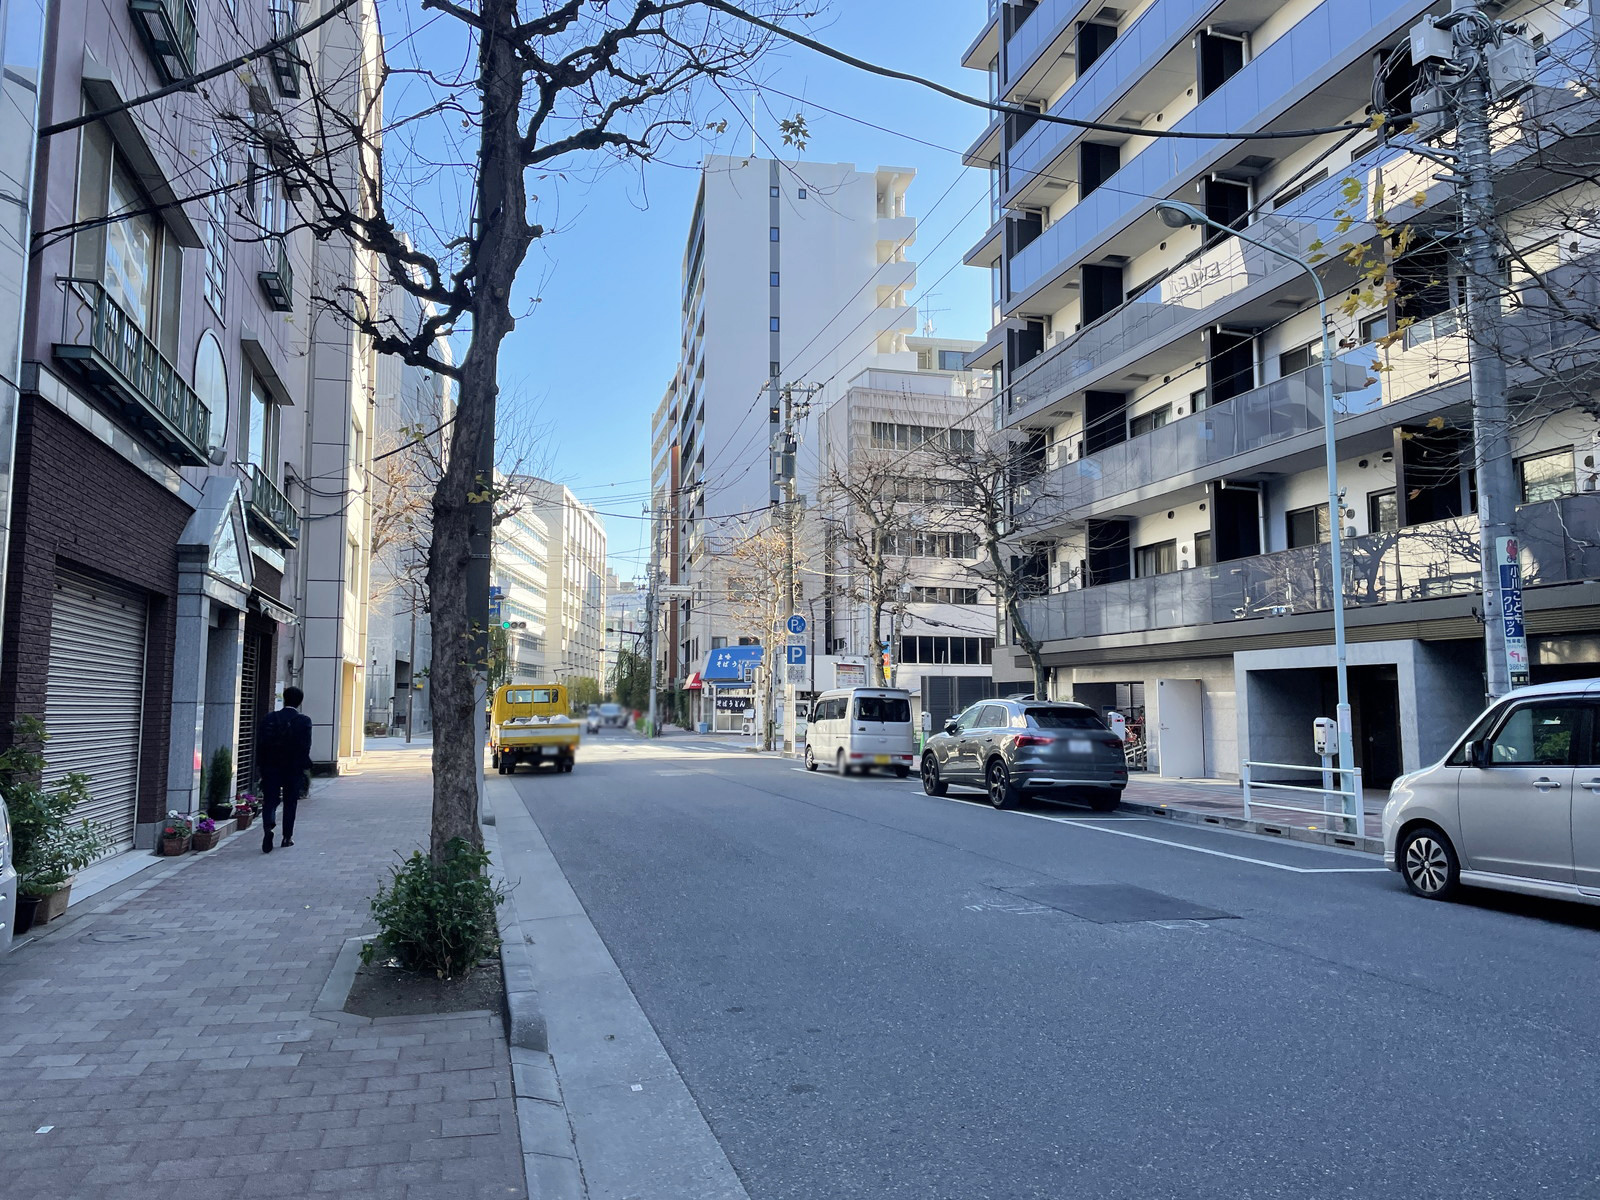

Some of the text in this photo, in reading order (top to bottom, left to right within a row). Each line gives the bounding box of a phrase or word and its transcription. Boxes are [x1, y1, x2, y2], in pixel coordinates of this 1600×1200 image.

[1503, 596, 1515, 636] クリニック
[791, 620, 799, 631] P
[792, 647, 803, 663] P
[717, 700, 746, 708] そばうどん
